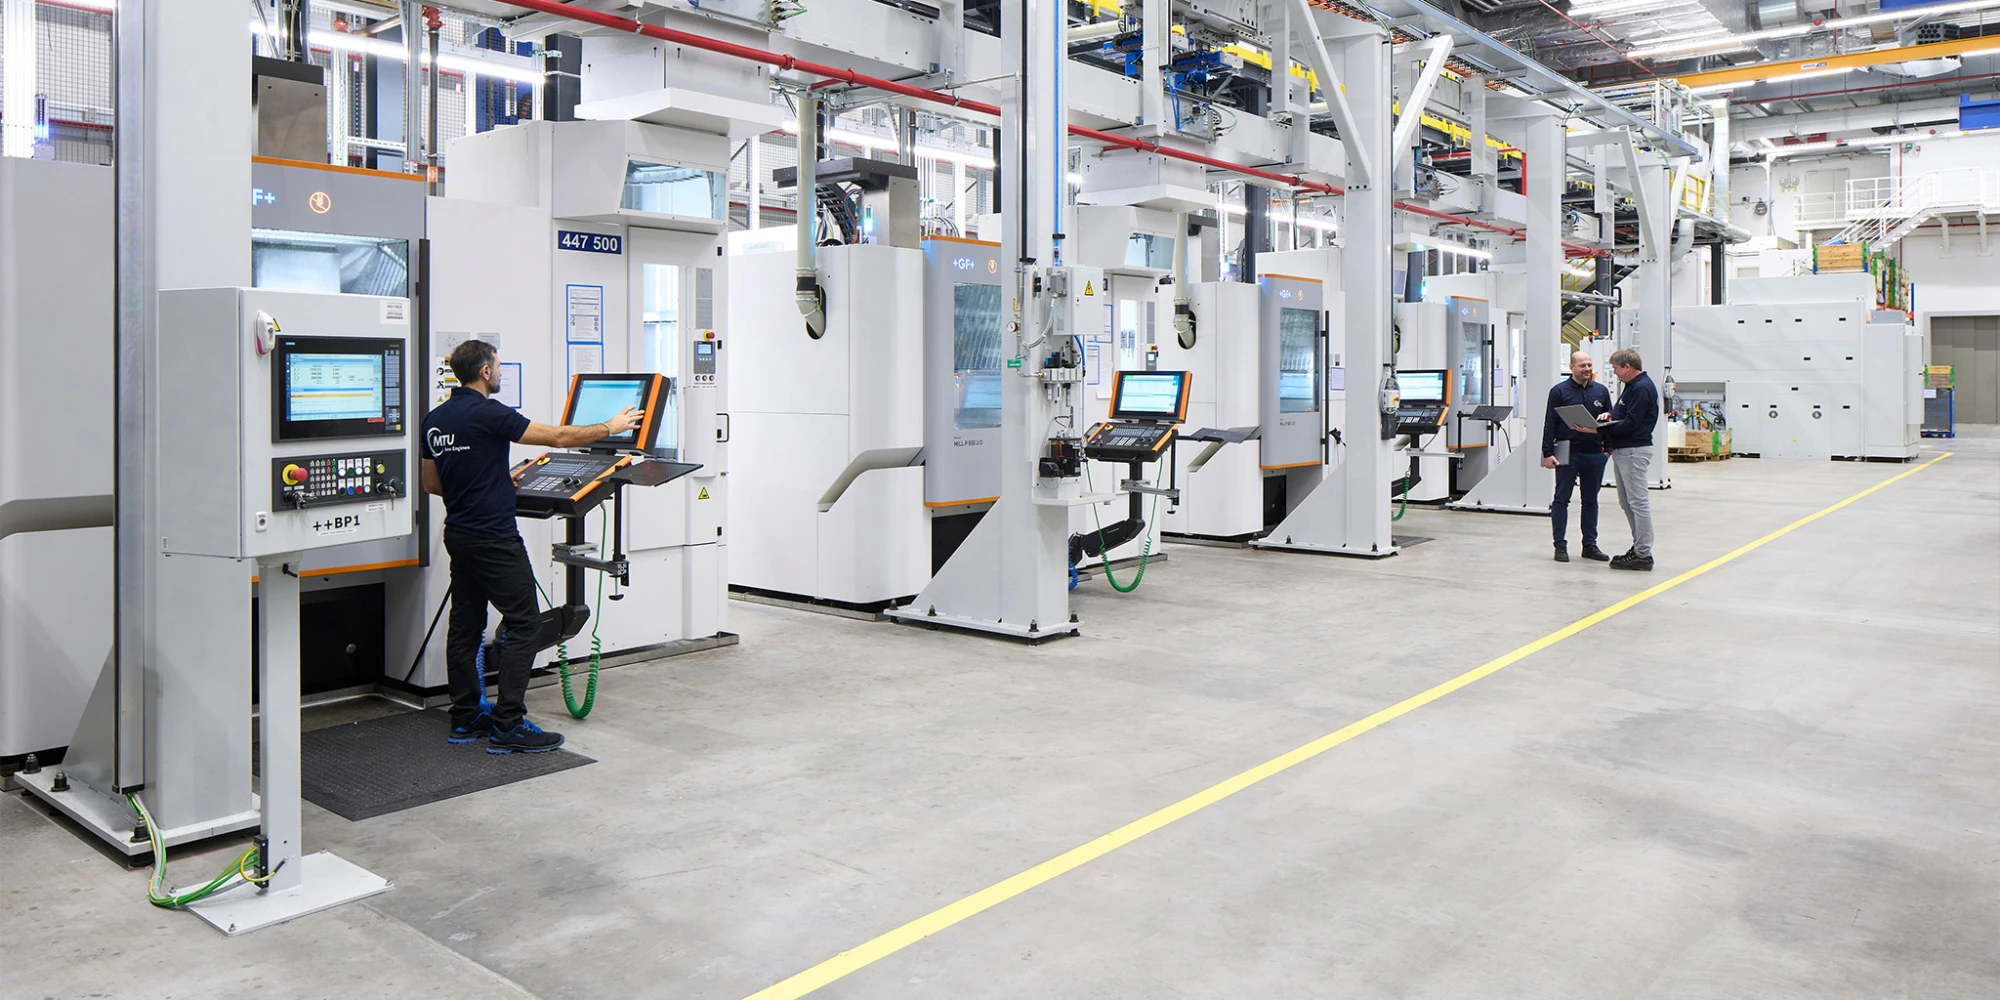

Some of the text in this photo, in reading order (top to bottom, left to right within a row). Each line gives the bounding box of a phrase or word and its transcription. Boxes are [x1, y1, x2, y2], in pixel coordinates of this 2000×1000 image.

[562, 233, 618, 252] 447 500
[953, 258, 976, 270] +GF+
[433, 433, 455, 447] MTU
[312, 514, 361, 532] ++BP1
